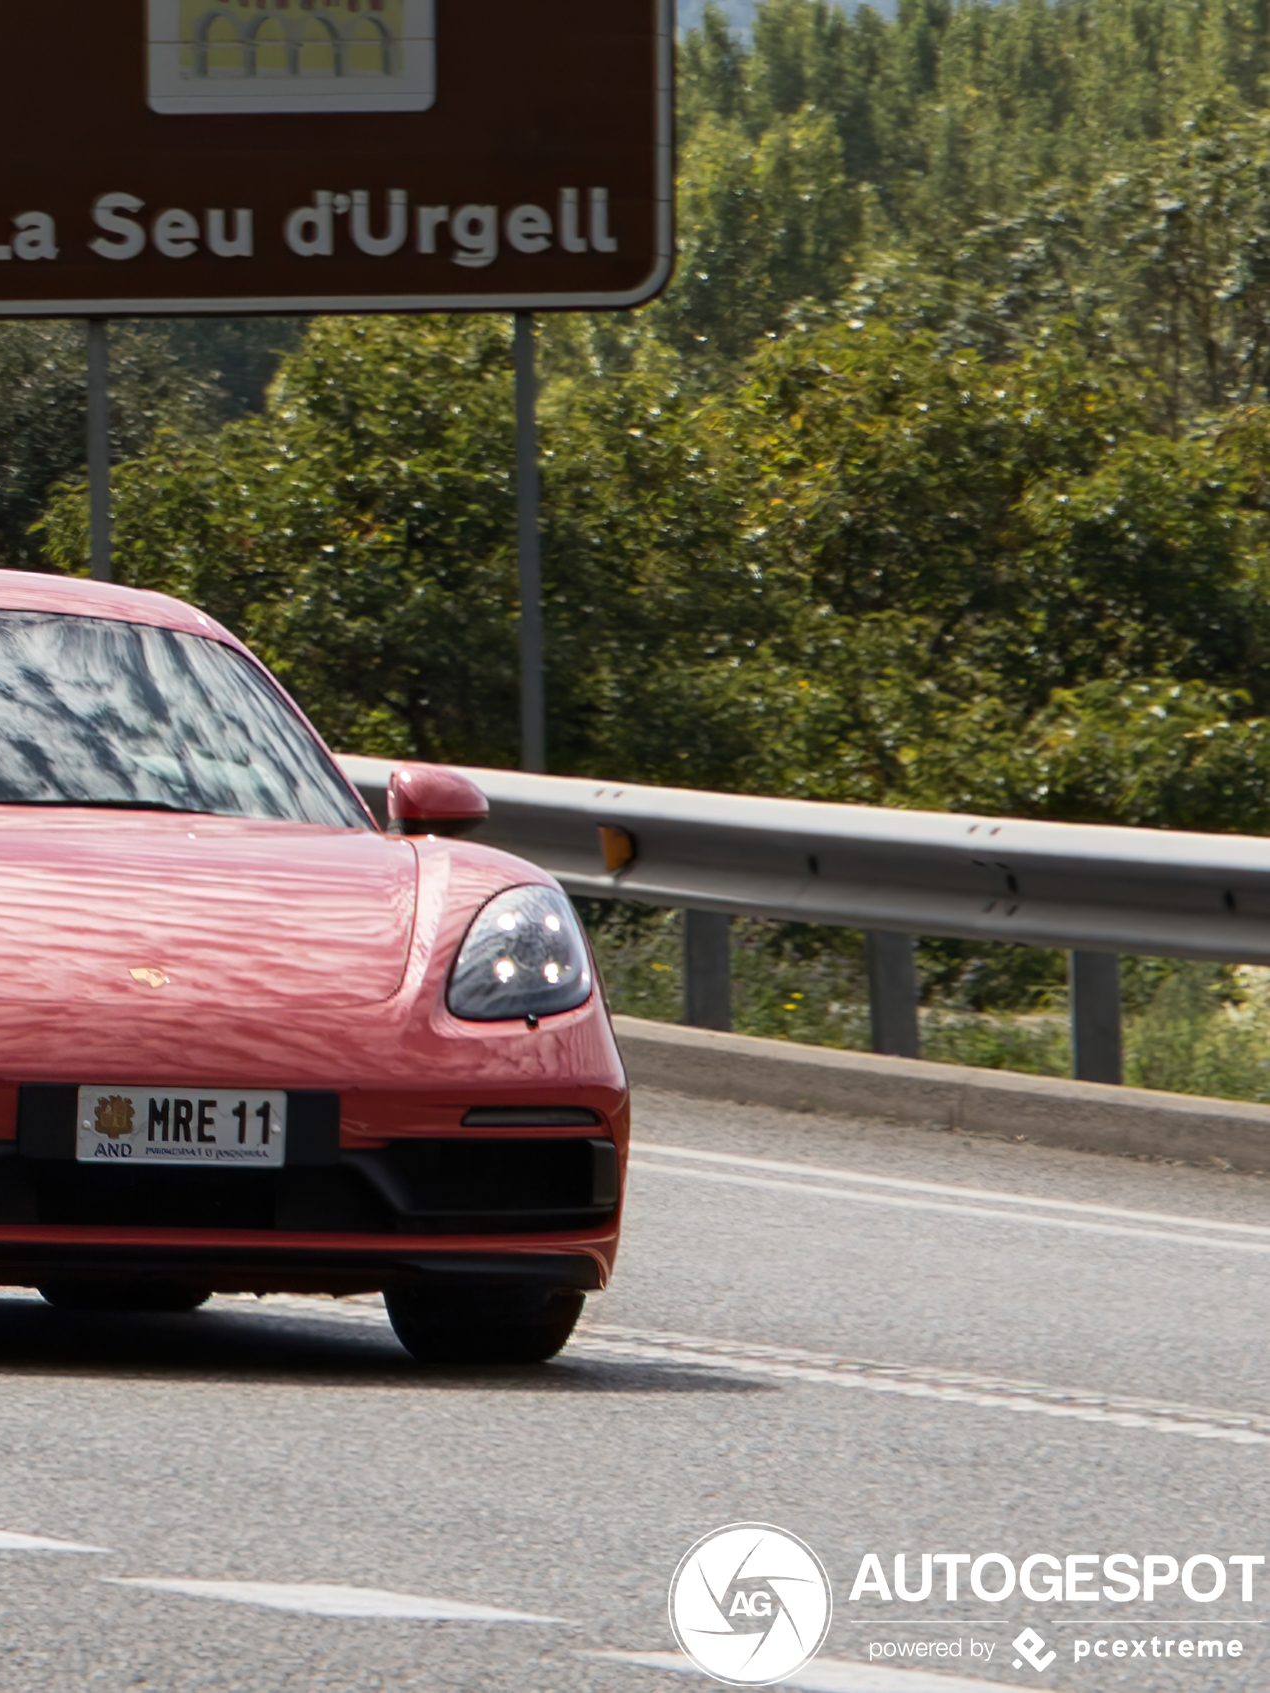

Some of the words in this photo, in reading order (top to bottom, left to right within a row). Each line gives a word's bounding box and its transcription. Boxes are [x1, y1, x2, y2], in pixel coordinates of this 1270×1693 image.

[89, 190, 254, 260] Seu
[284, 187, 618, 268] d'Urgell
[147, 1097, 218, 1144] MRE
[231, 1100, 271, 1145] 11
[94, 1142, 133, 1158] AND
